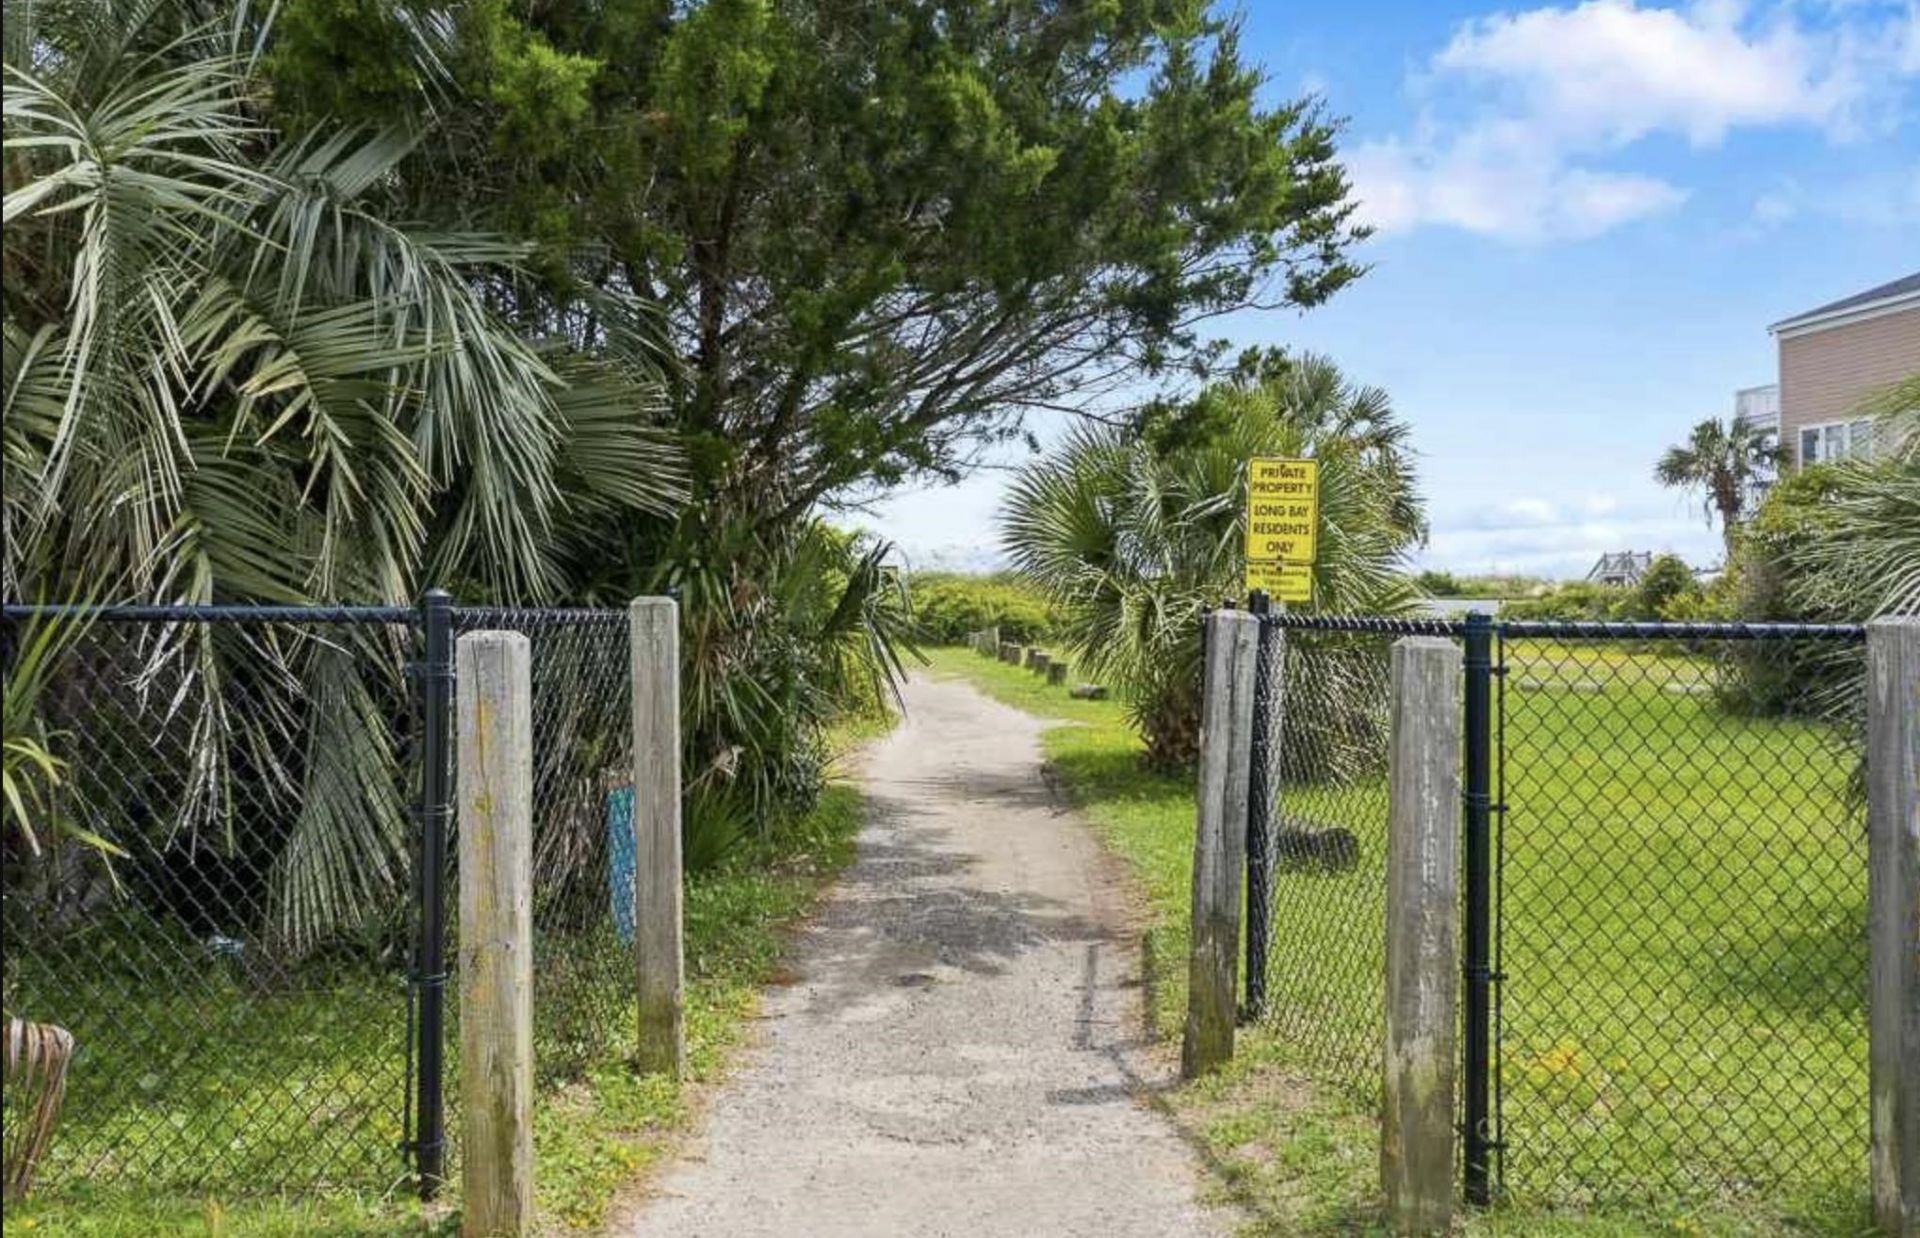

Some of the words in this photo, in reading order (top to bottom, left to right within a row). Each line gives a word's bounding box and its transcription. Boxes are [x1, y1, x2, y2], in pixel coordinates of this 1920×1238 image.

[1260, 467, 1307, 479] PRIVATE
[1253, 482, 1312, 493] PROPERTY
[1254, 505, 1286, 517] LONG
[1288, 506, 1309, 517] BAY
[1253, 522, 1309, 535] RESIDENTS
[1266, 541, 1294, 553] ONLY
